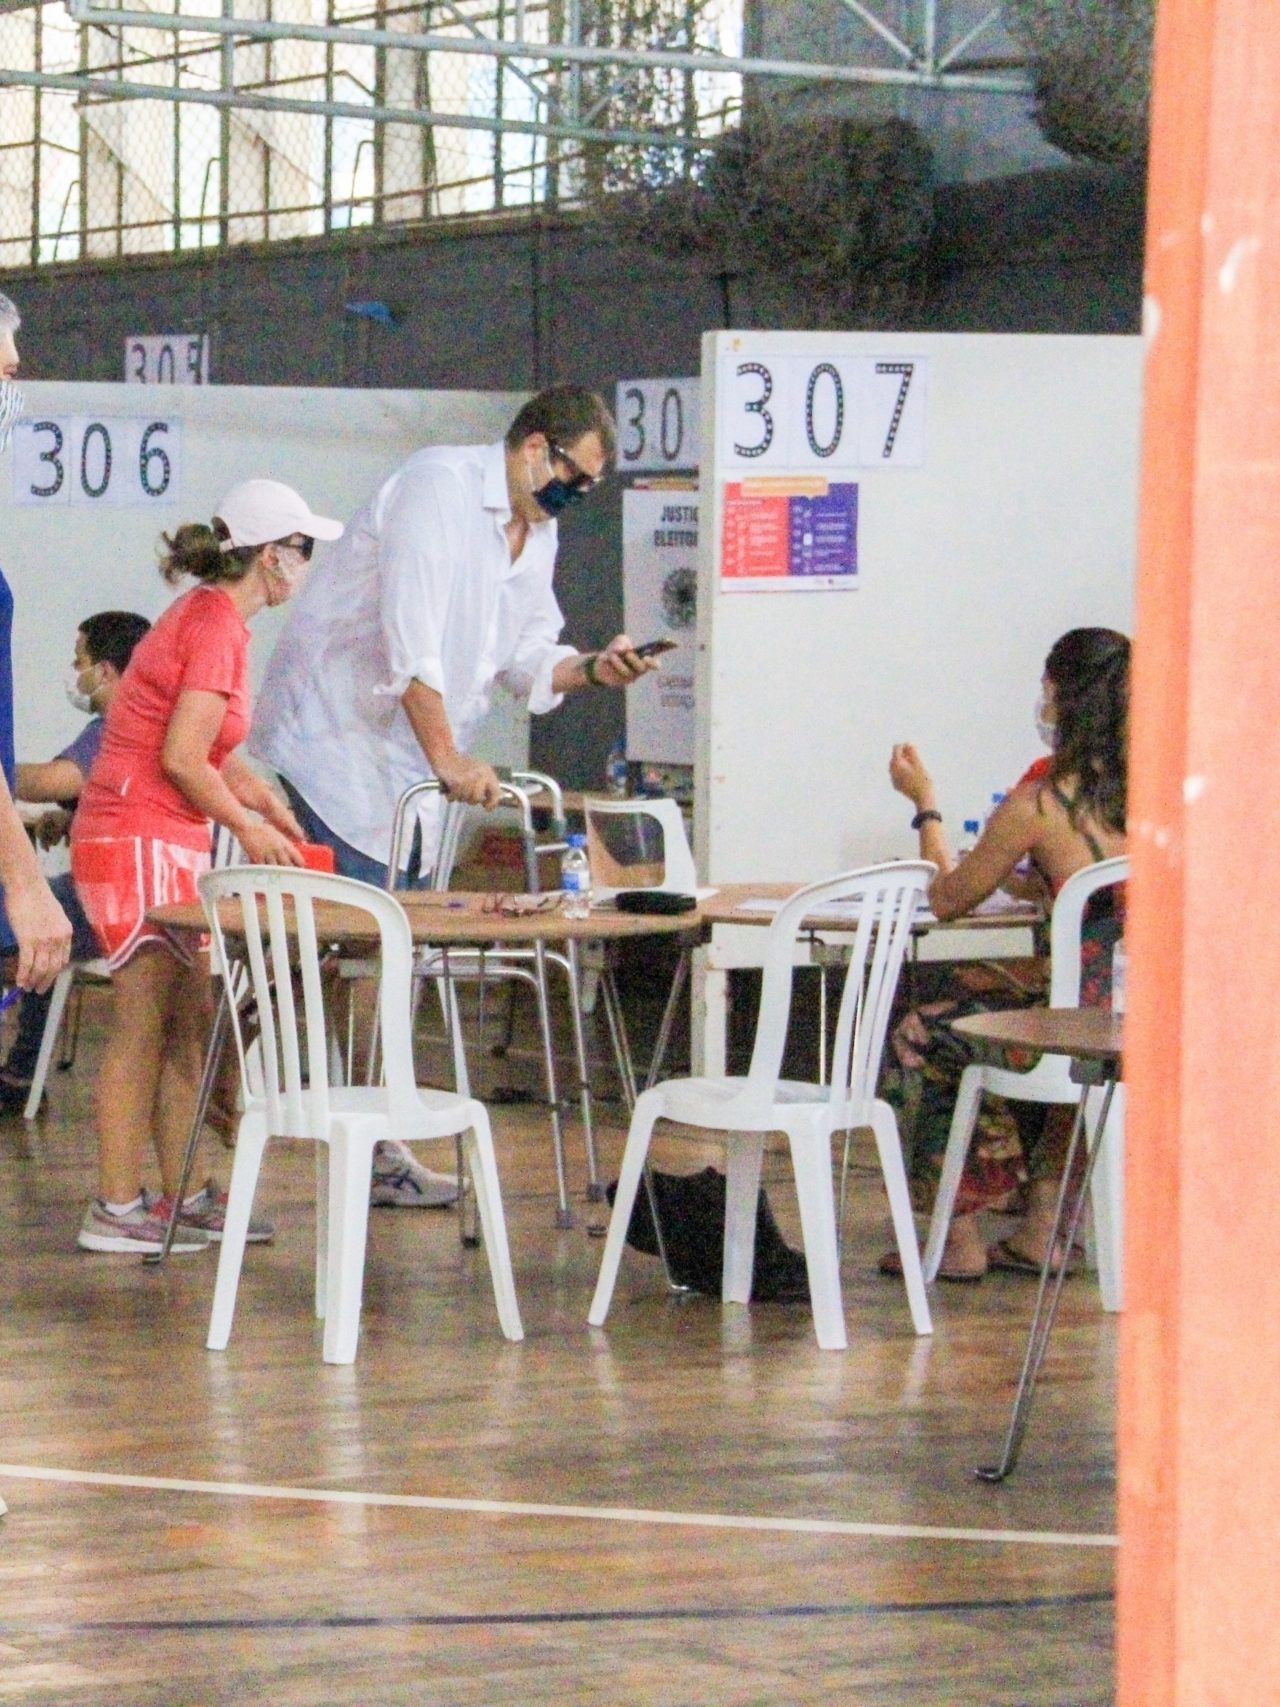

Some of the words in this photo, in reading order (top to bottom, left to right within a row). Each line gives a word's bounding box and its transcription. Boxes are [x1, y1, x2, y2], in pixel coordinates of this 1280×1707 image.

[623, 387, 683, 461] 30
[734, 362, 914, 458] 307
[30, 421, 170, 498] 306
